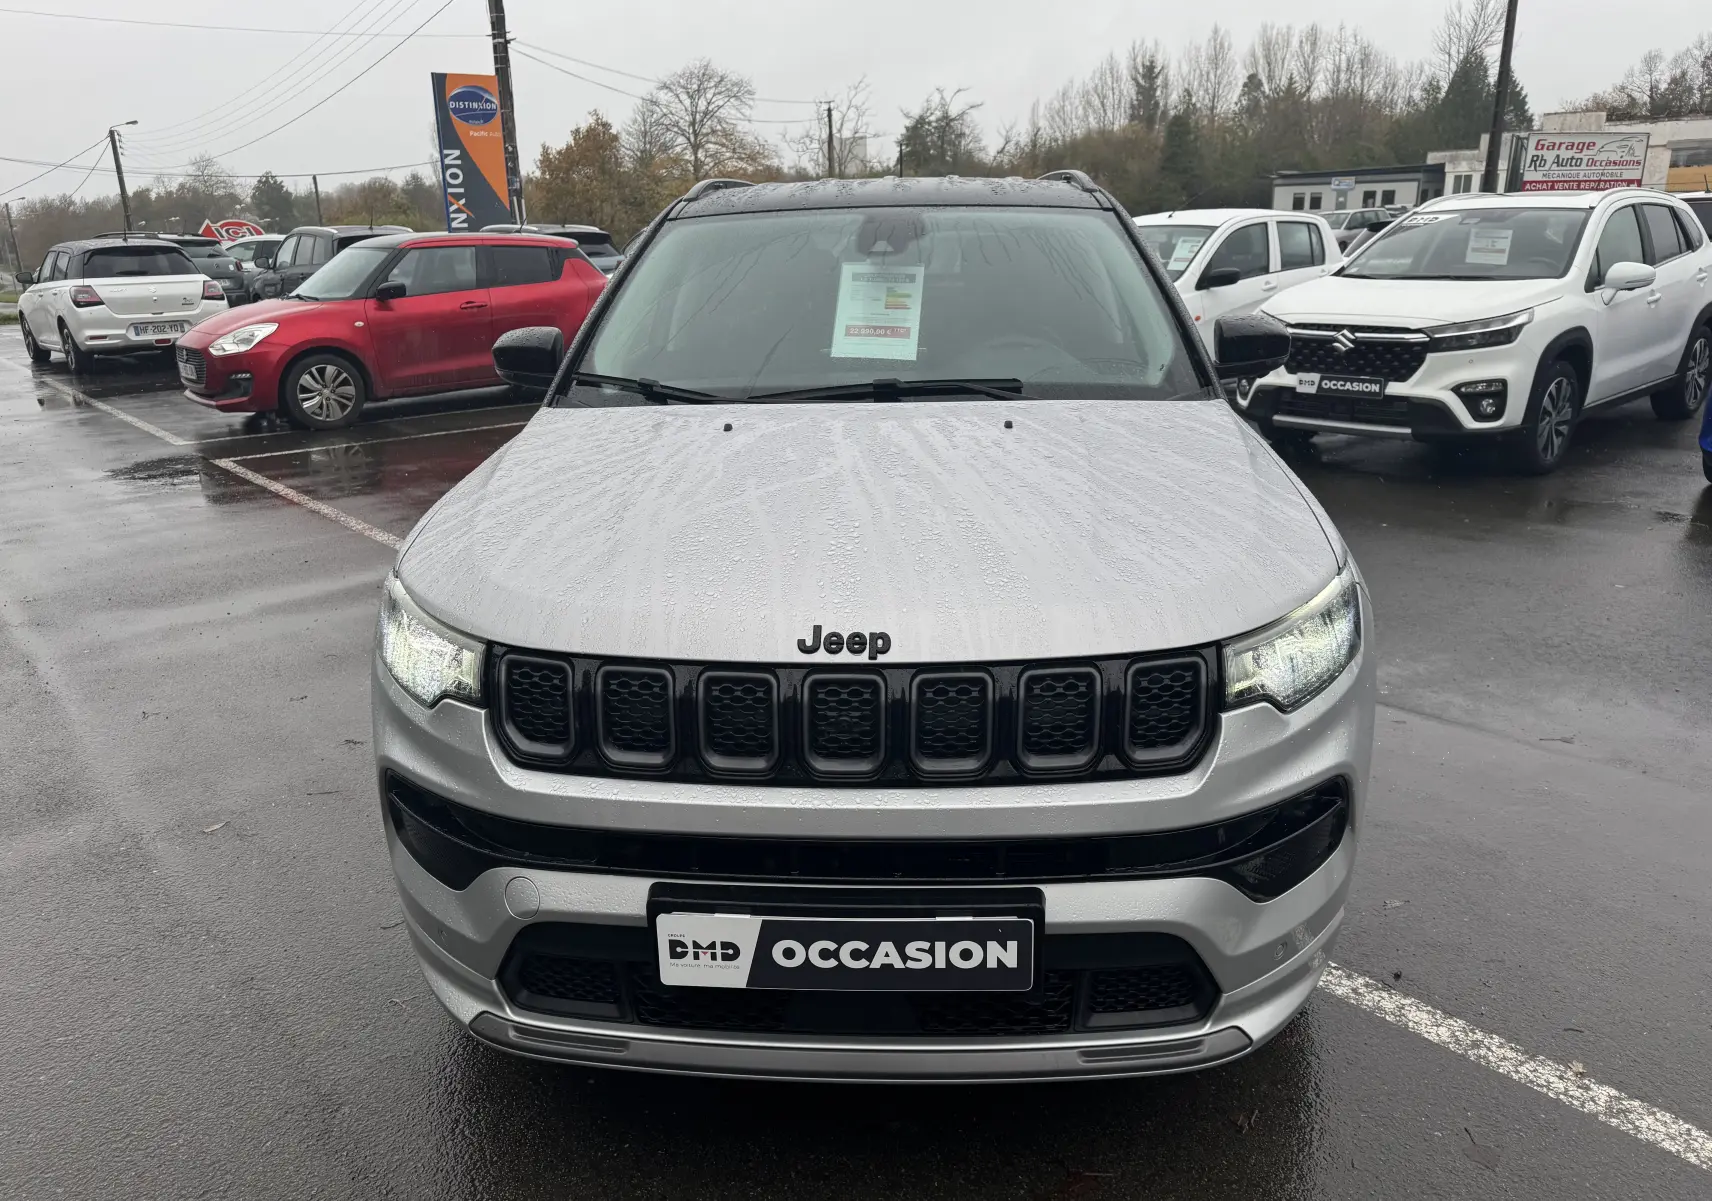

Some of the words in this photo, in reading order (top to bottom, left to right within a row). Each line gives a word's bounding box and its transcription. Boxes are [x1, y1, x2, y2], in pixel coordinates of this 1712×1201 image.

[450, 100, 497, 110] DISTINXION
[1535, 139, 1596, 153] Garage
[1528, 154, 1547, 171] Rb
[1547, 154, 1583, 172] Auto
[1585, 157, 1642, 168] Occasions
[1582, 171, 1624, 179] AUTOMOBILE
[1524, 182, 1552, 191] ACHAT
[1553, 181, 1579, 190] VENTE
[212, 226, 258, 239] ICI
[1298, 379, 1316, 387] DMD
[1321, 380, 1380, 392] OCCASION
[797, 624, 892, 661] Jeep
[668, 939, 741, 962] DMD
[771, 939, 1018, 969] OCCASION
